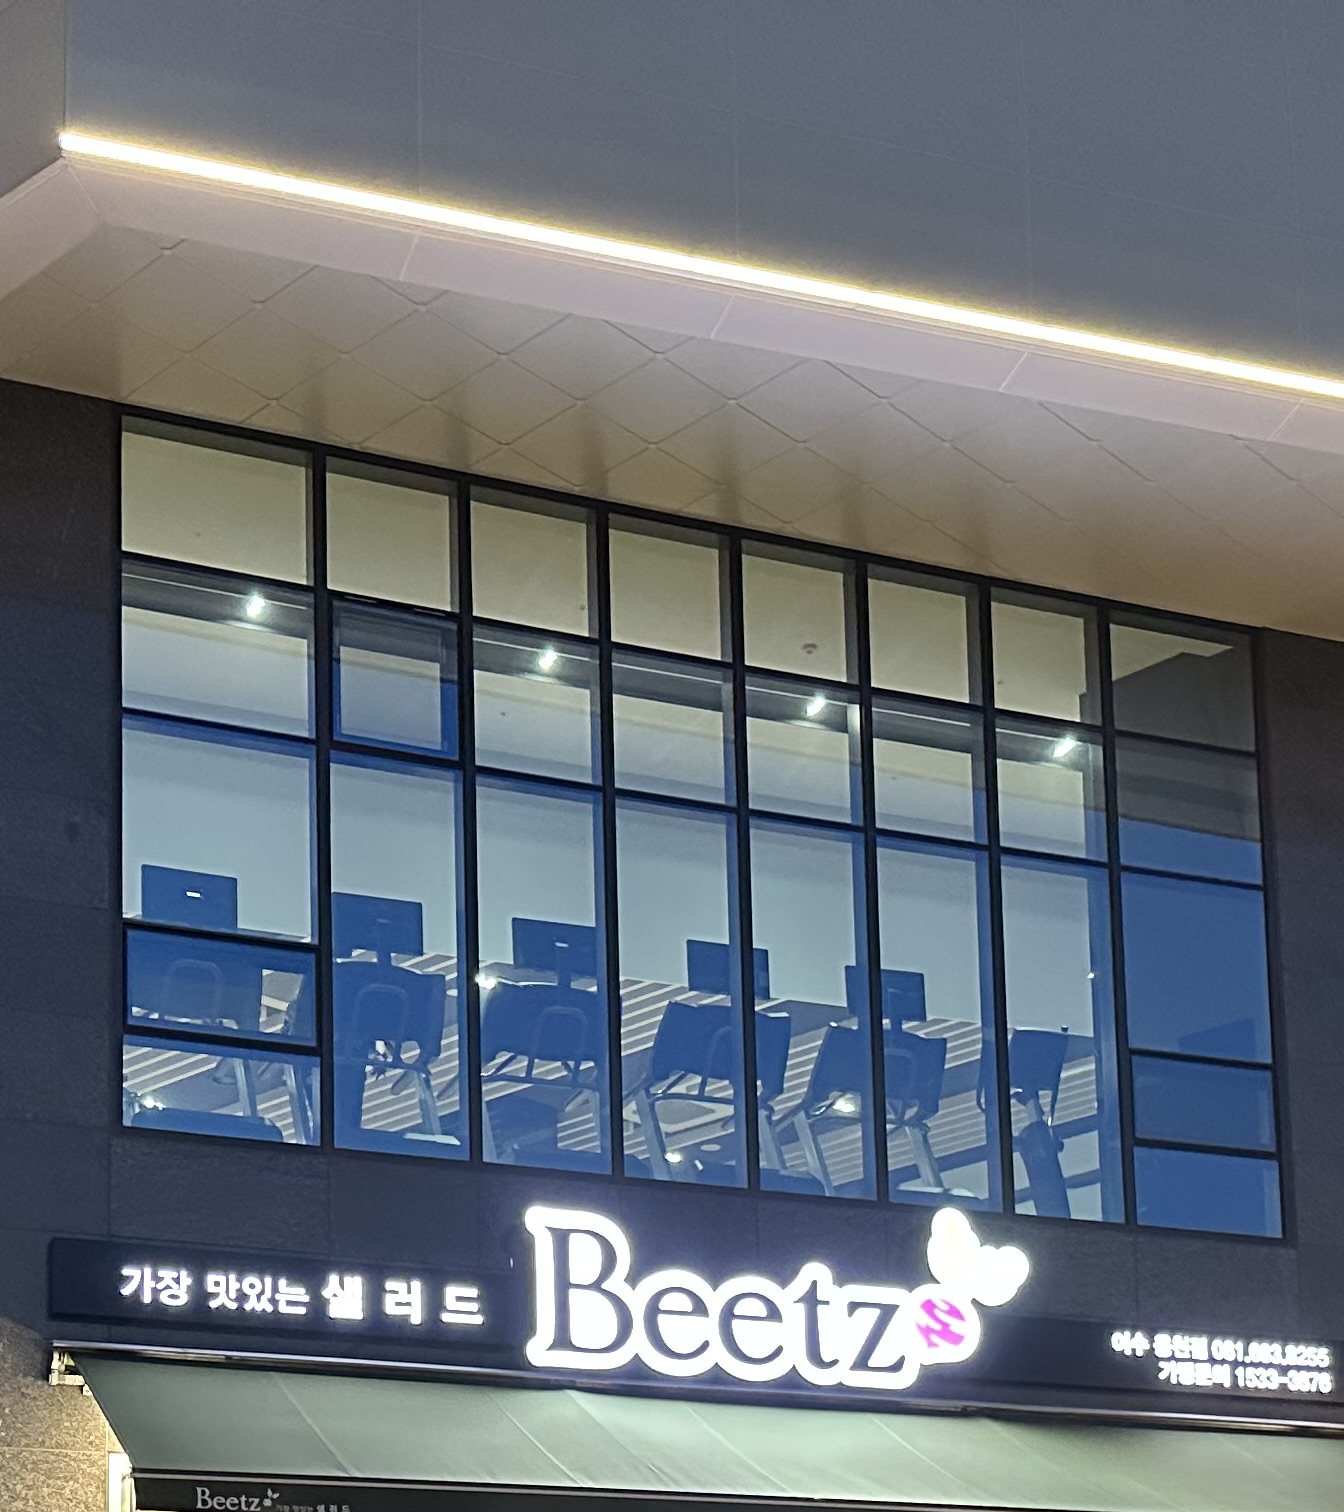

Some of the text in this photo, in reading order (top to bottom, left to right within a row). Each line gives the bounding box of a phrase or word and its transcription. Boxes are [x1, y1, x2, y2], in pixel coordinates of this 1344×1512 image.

[119, 1264, 193, 1308] 가장
[205, 1270, 311, 1316] 맛있는
[532, 1213, 914, 1382] Beetz
[196, 1486, 262, 1512] Beetz
